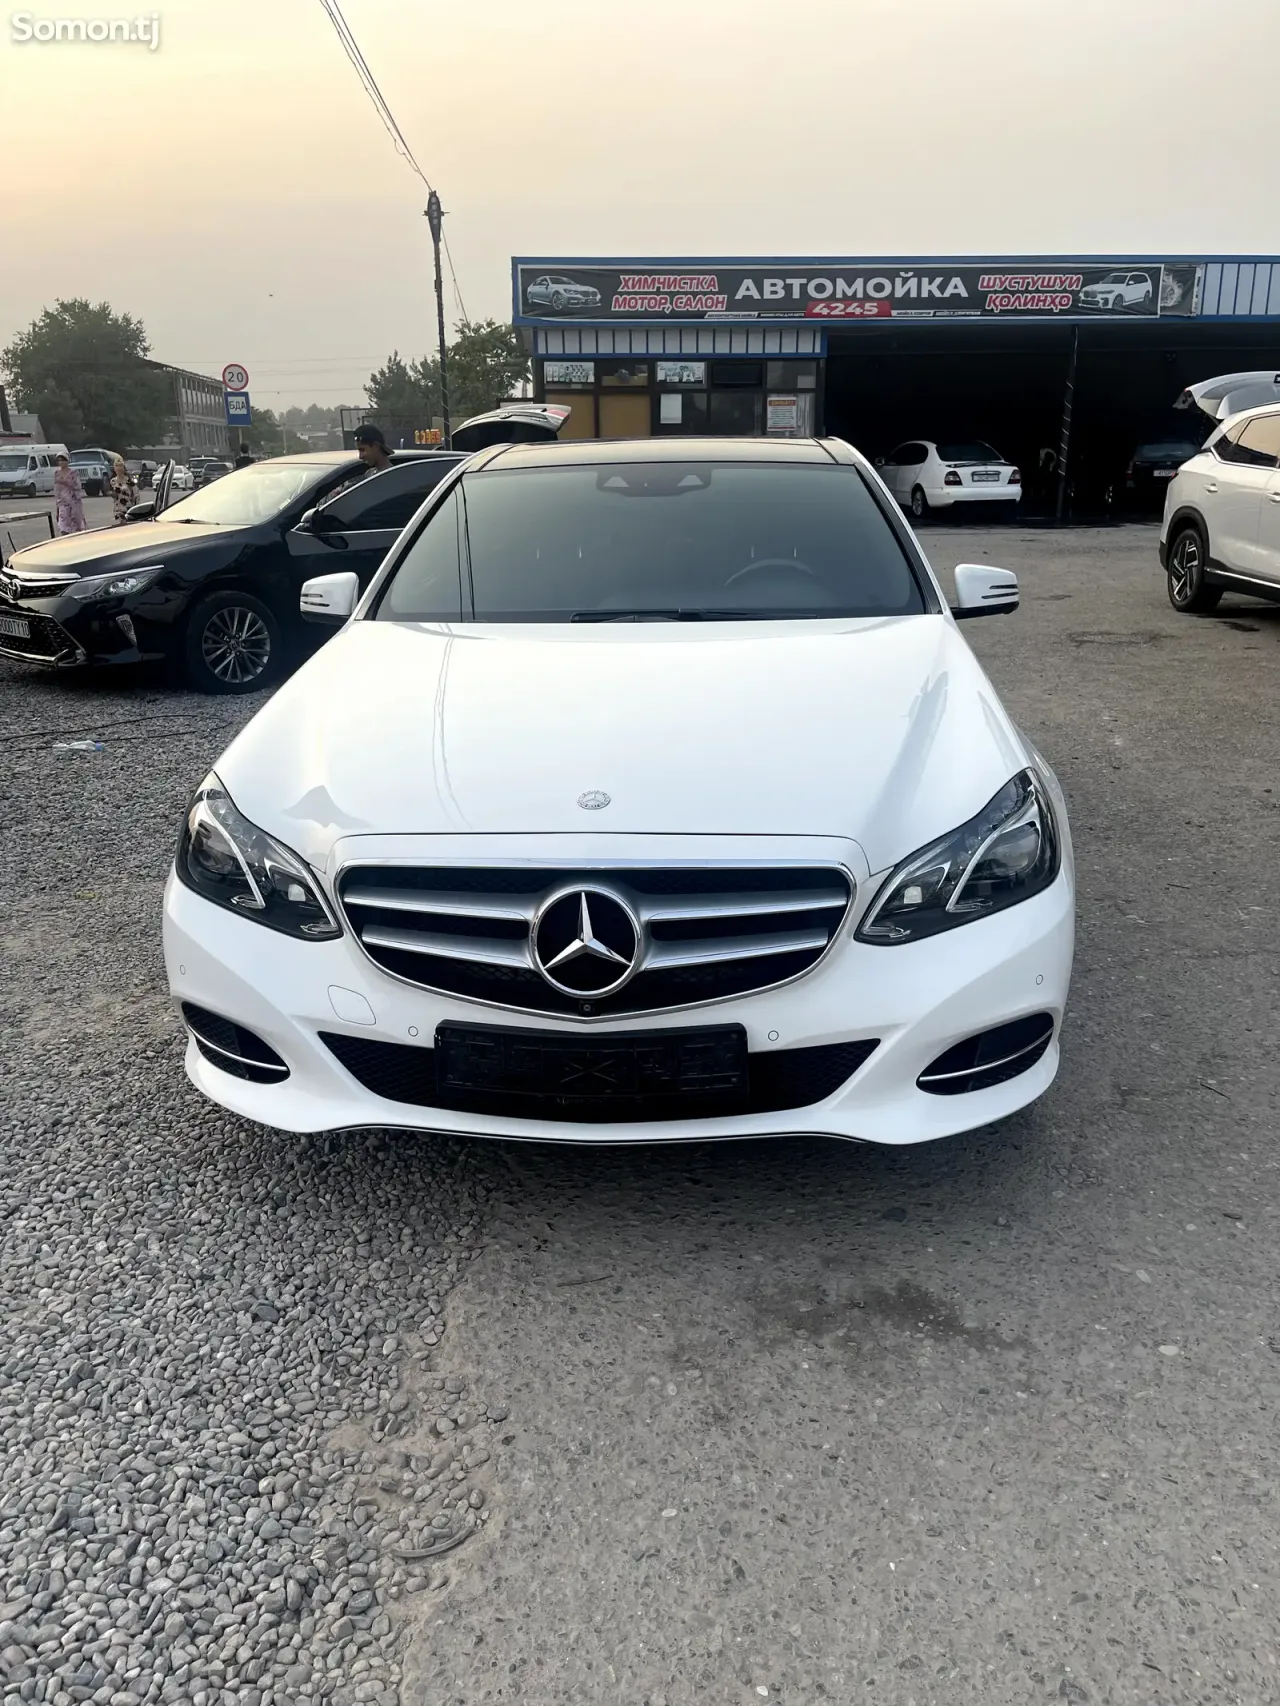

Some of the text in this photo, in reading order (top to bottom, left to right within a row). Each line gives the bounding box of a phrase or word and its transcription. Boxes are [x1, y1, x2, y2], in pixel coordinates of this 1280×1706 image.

[618, 275, 718, 291] ХИМЧИСТКА
[734, 271, 969, 299] АВТОМОЙКА
[978, 275, 1082, 290] ШУСТУШУИ
[611, 295, 727, 313] МОТОР, САЛОН
[812, 303, 878, 315] 4245
[227, 371, 244, 383] 20
[229, 401, 246, 411] БДА
